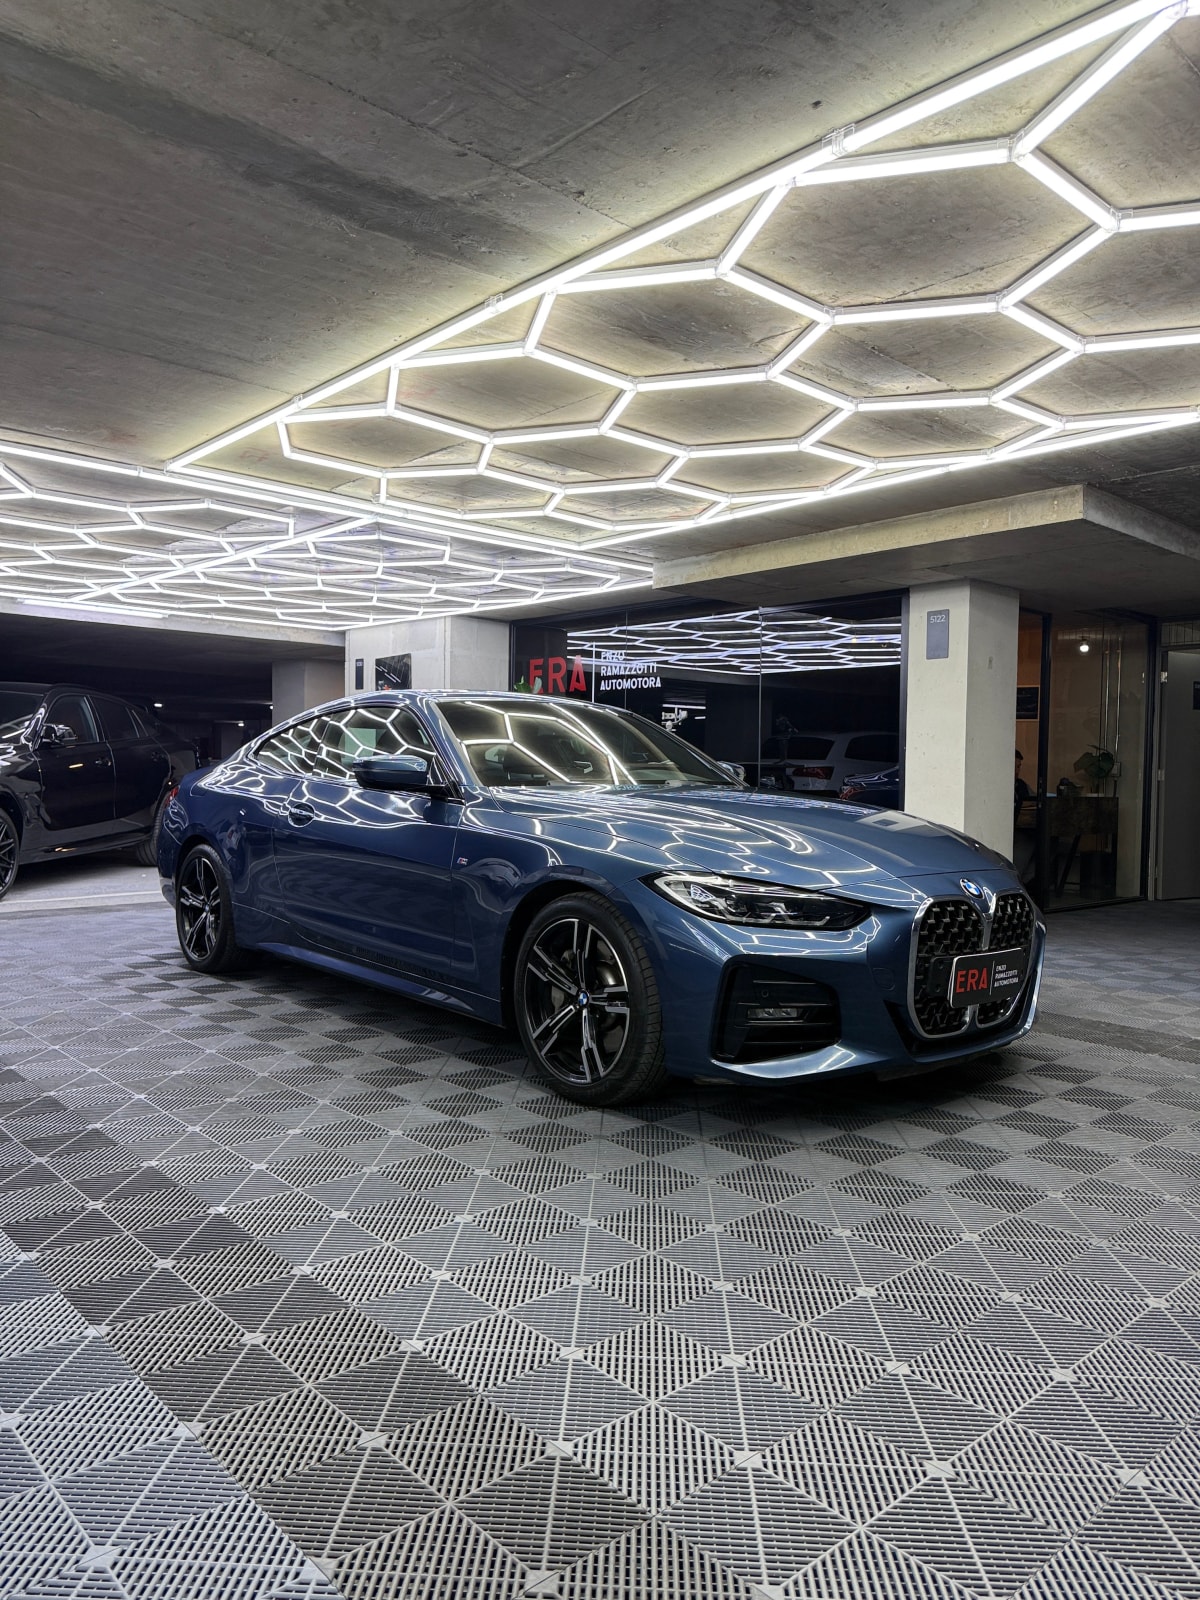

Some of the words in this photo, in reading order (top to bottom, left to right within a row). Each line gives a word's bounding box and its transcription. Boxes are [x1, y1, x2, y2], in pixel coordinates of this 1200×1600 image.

[930, 614, 946, 624] 5122
[600, 651, 625, 661] ENZO
[529, 655, 587, 694] ERA
[600, 662, 657, 676] RAMAZZOTTI
[600, 677, 661, 691] AUTOMOTORA
[956, 967, 988, 993] ERA
